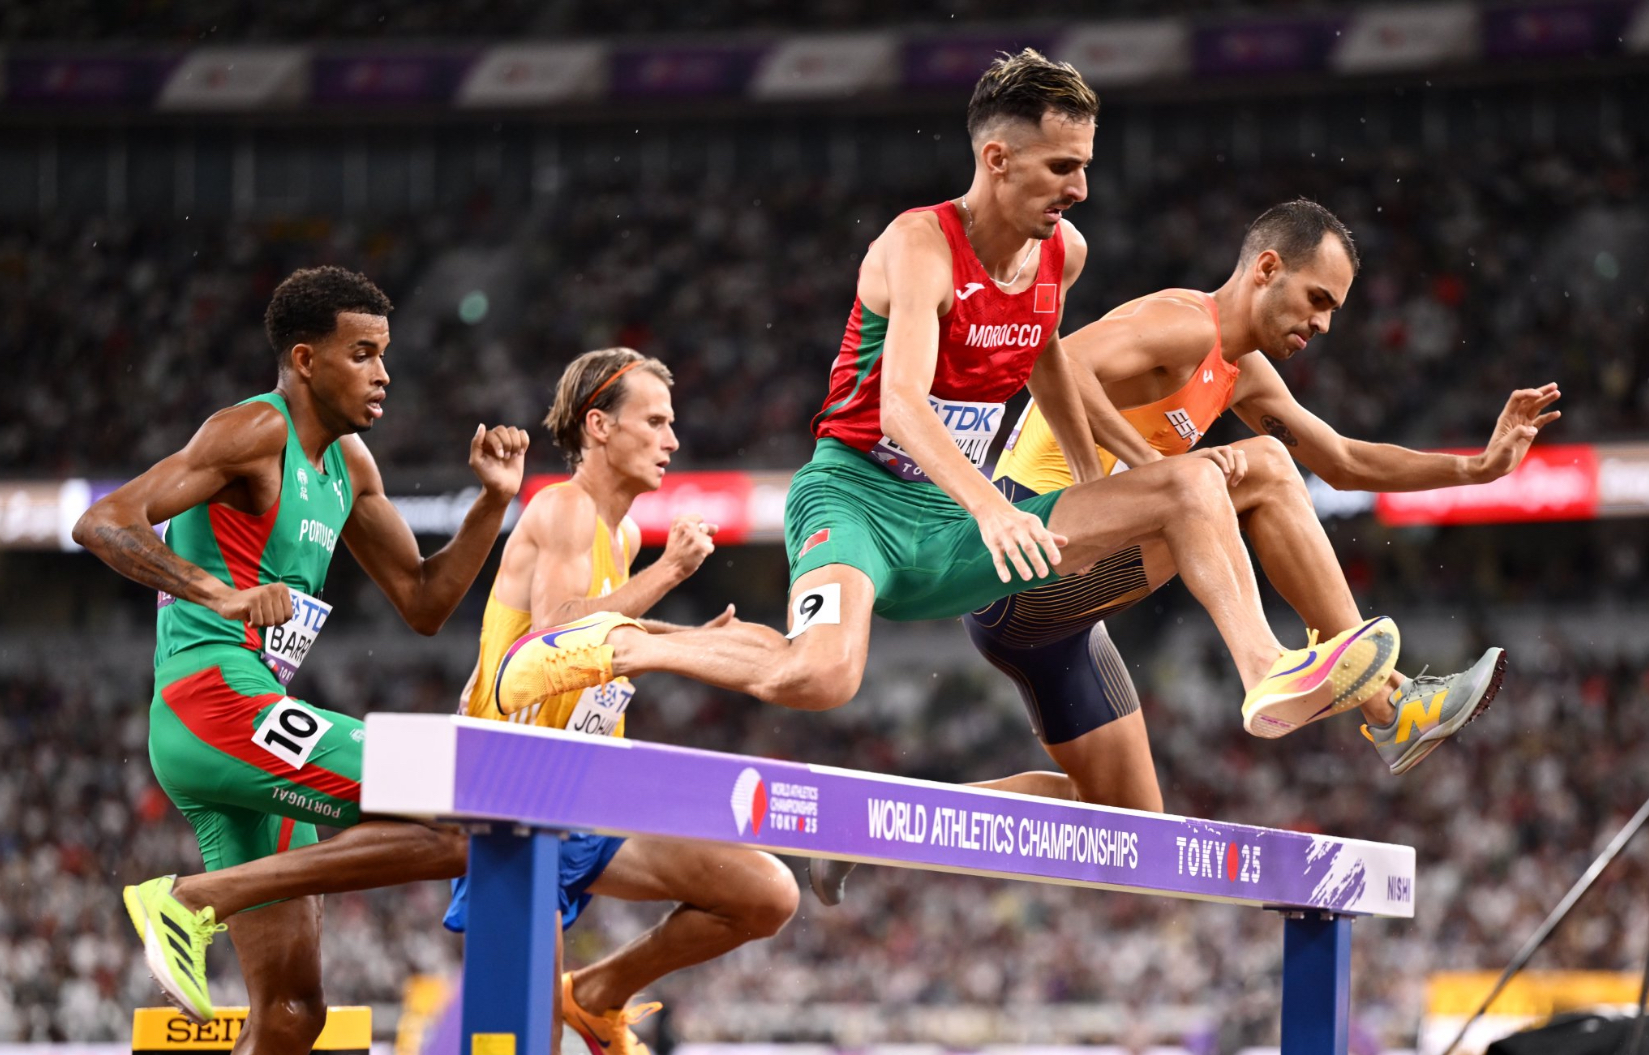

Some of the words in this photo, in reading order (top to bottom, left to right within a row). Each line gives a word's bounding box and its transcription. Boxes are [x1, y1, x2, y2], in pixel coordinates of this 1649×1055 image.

[965, 323, 1042, 348] MOROCCO
[942, 404, 999, 432] TDK
[800, 594, 824, 625] 9
[263, 708, 318, 756] 10
[272, 786, 341, 818] PORTUGAL
[867, 797, 927, 844] WORLD
[930, 806, 1014, 855] ATHLETICS
[1018, 817, 1138, 869] CHAMPIONSHIPS
[1387, 874, 1411, 903] NISHI
